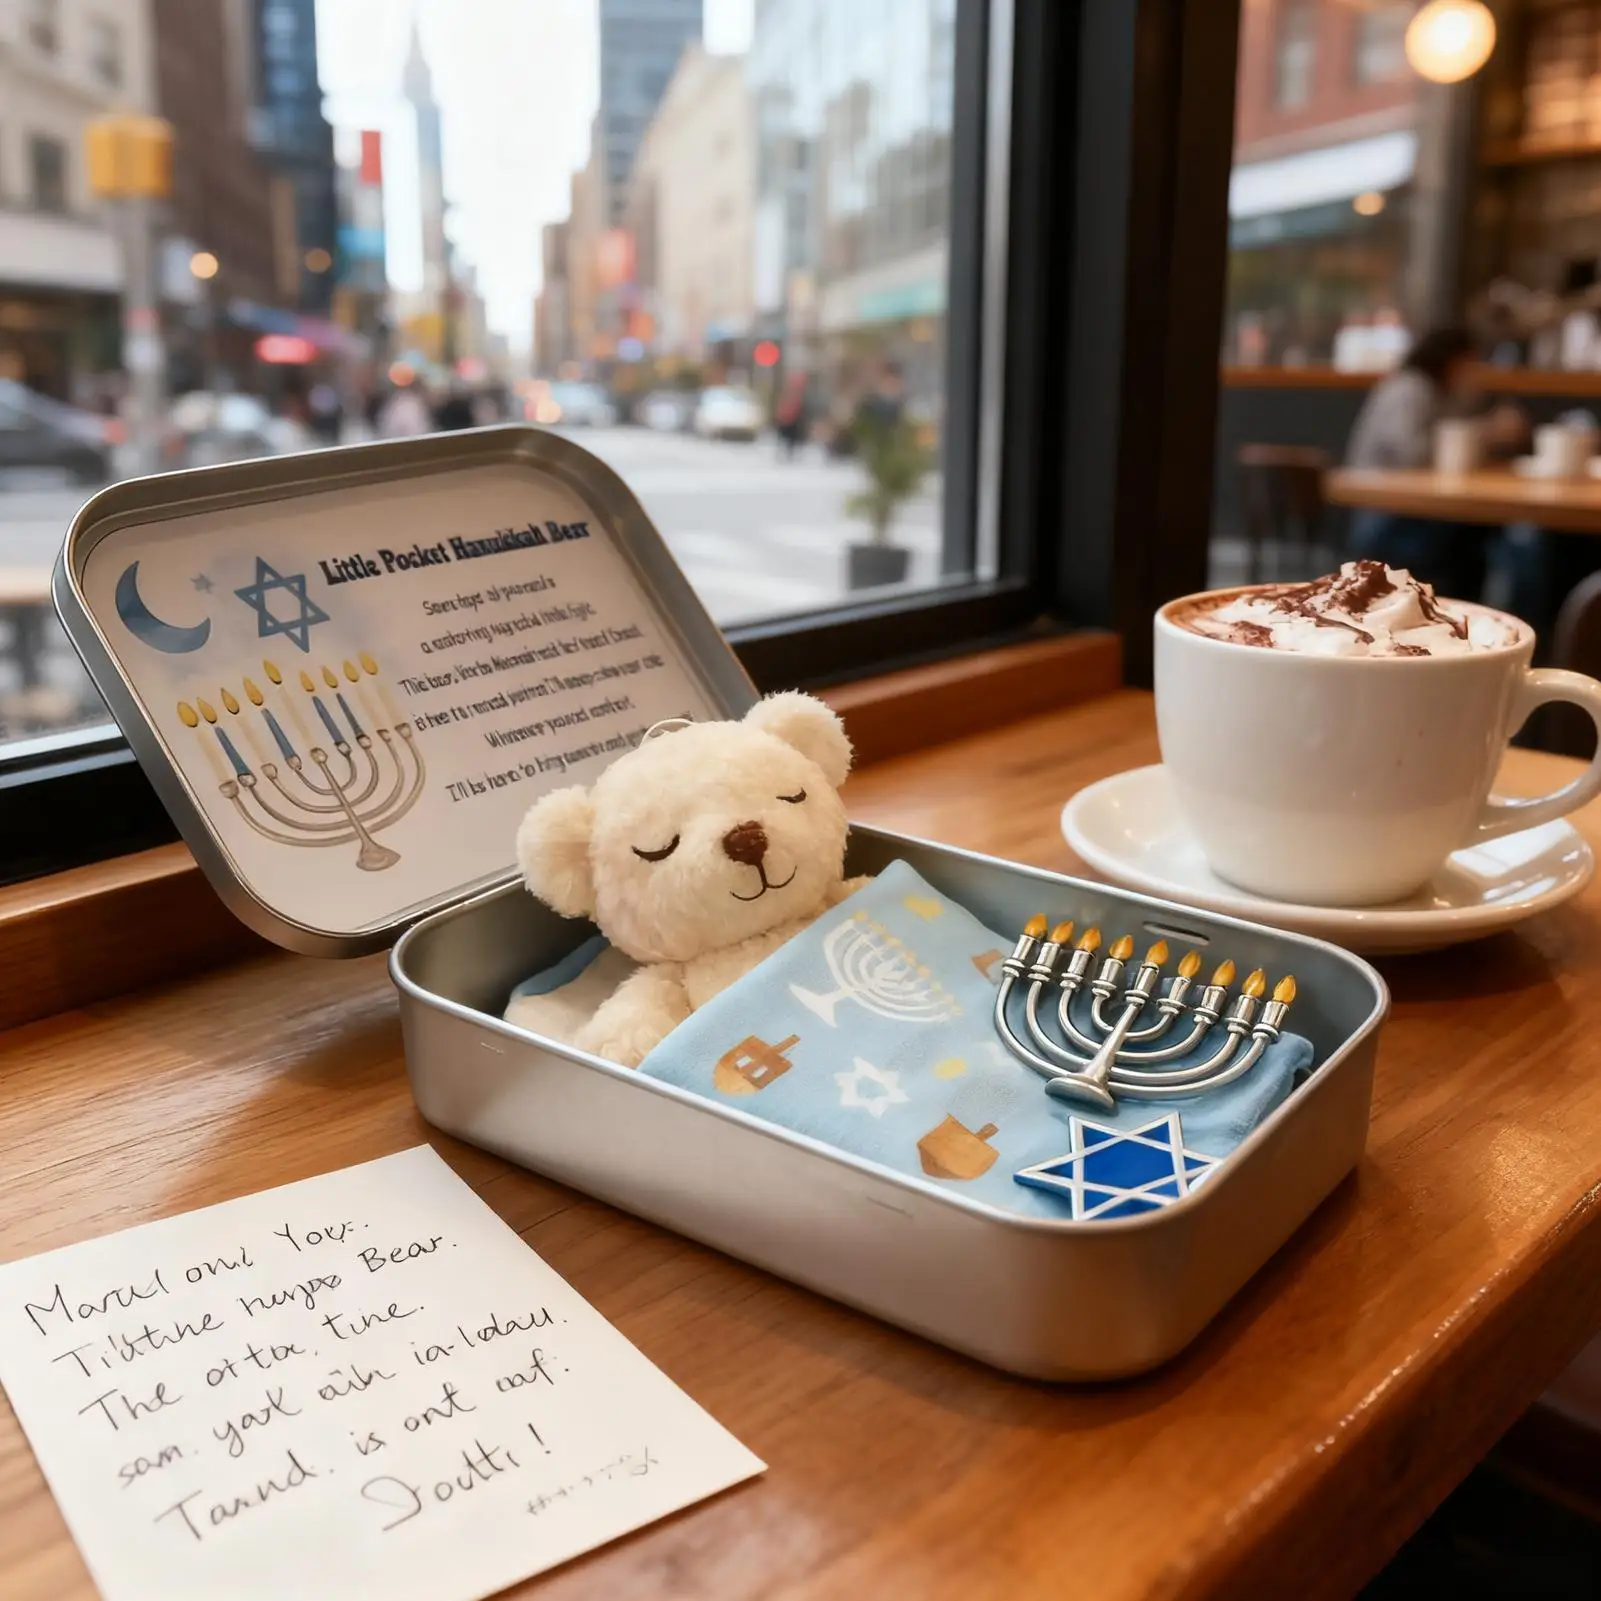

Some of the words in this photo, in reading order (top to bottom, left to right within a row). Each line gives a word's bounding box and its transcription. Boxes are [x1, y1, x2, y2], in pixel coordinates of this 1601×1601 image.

[318, 554, 382, 585] Little
[378, 542, 451, 573] Pocket
[78, 1383, 184, 1431] The
